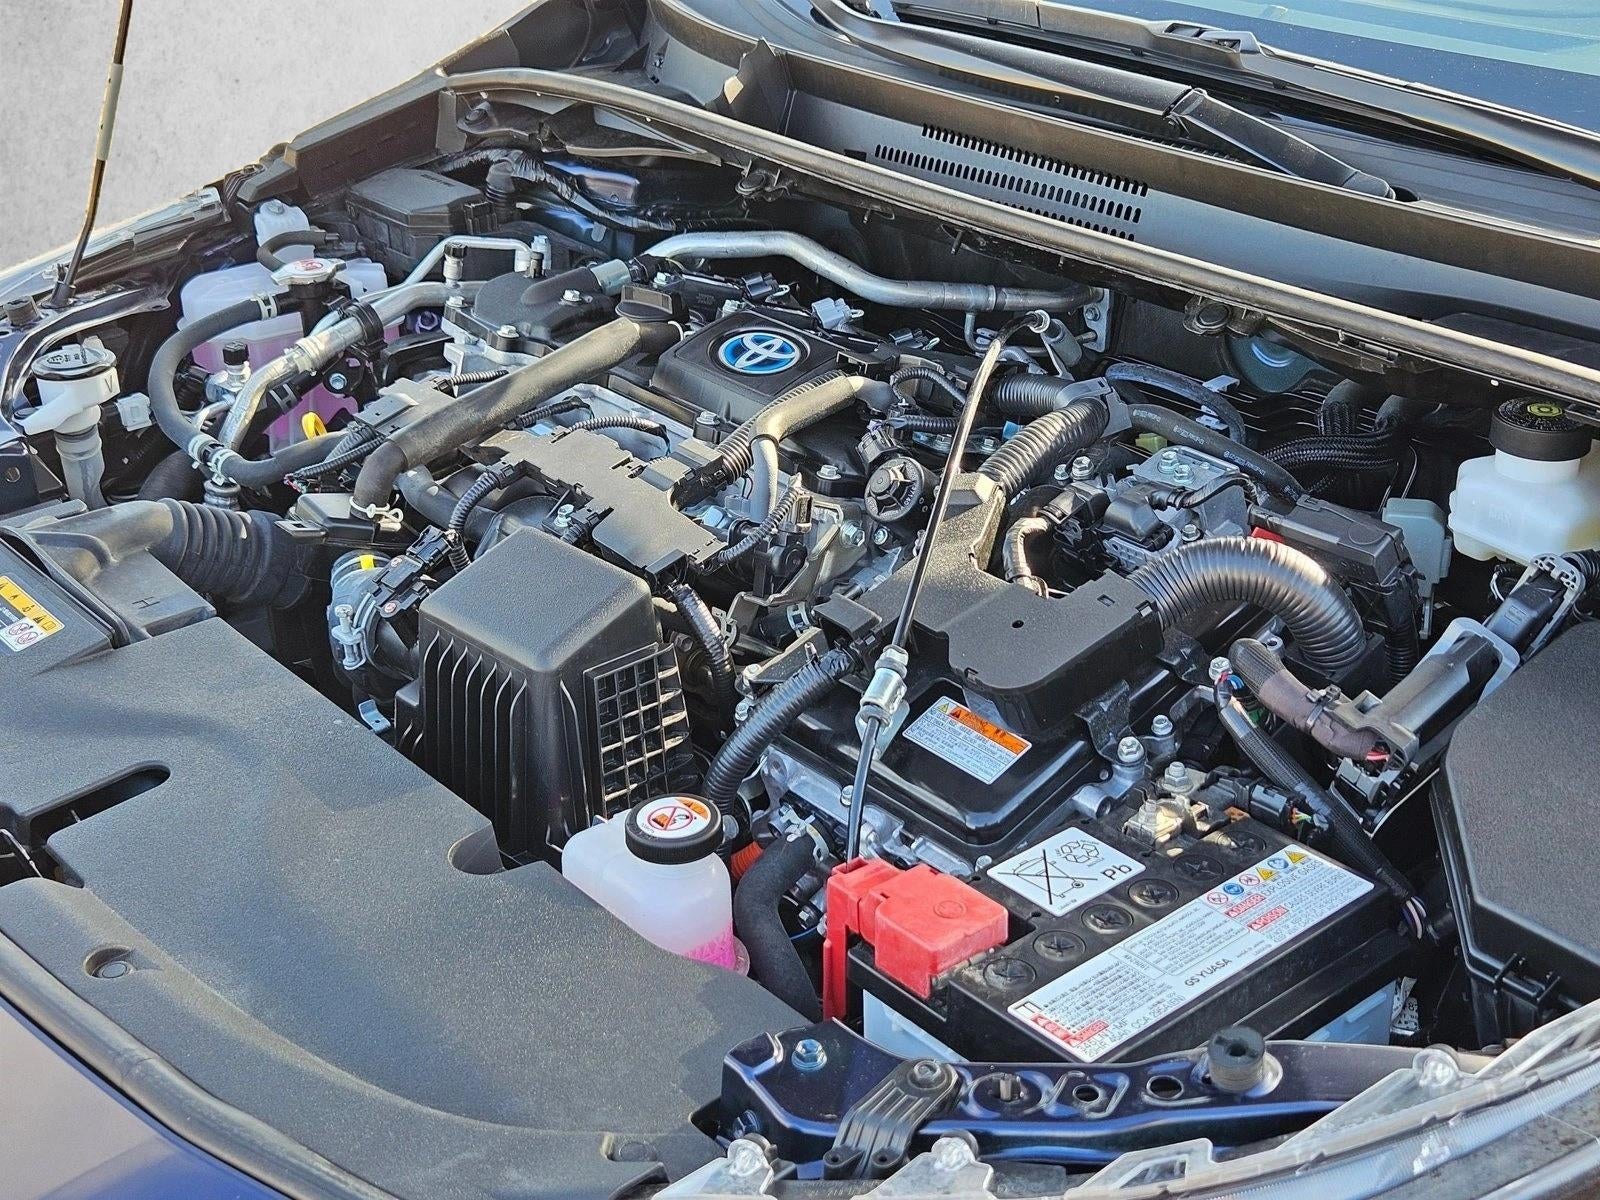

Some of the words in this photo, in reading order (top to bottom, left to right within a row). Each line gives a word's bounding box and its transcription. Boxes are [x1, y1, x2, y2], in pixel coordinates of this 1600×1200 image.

[1101, 864, 1132, 881] Pb
[1233, 893, 1264, 913] DANGER
[1261, 873, 1300, 897] EXPLOSIVE
[1255, 906, 1288, 926] POISON
[1184, 975, 1200, 987] GS
[1198, 957, 1232, 979] YUASA
[1130, 1014, 1151, 1029] CCA
